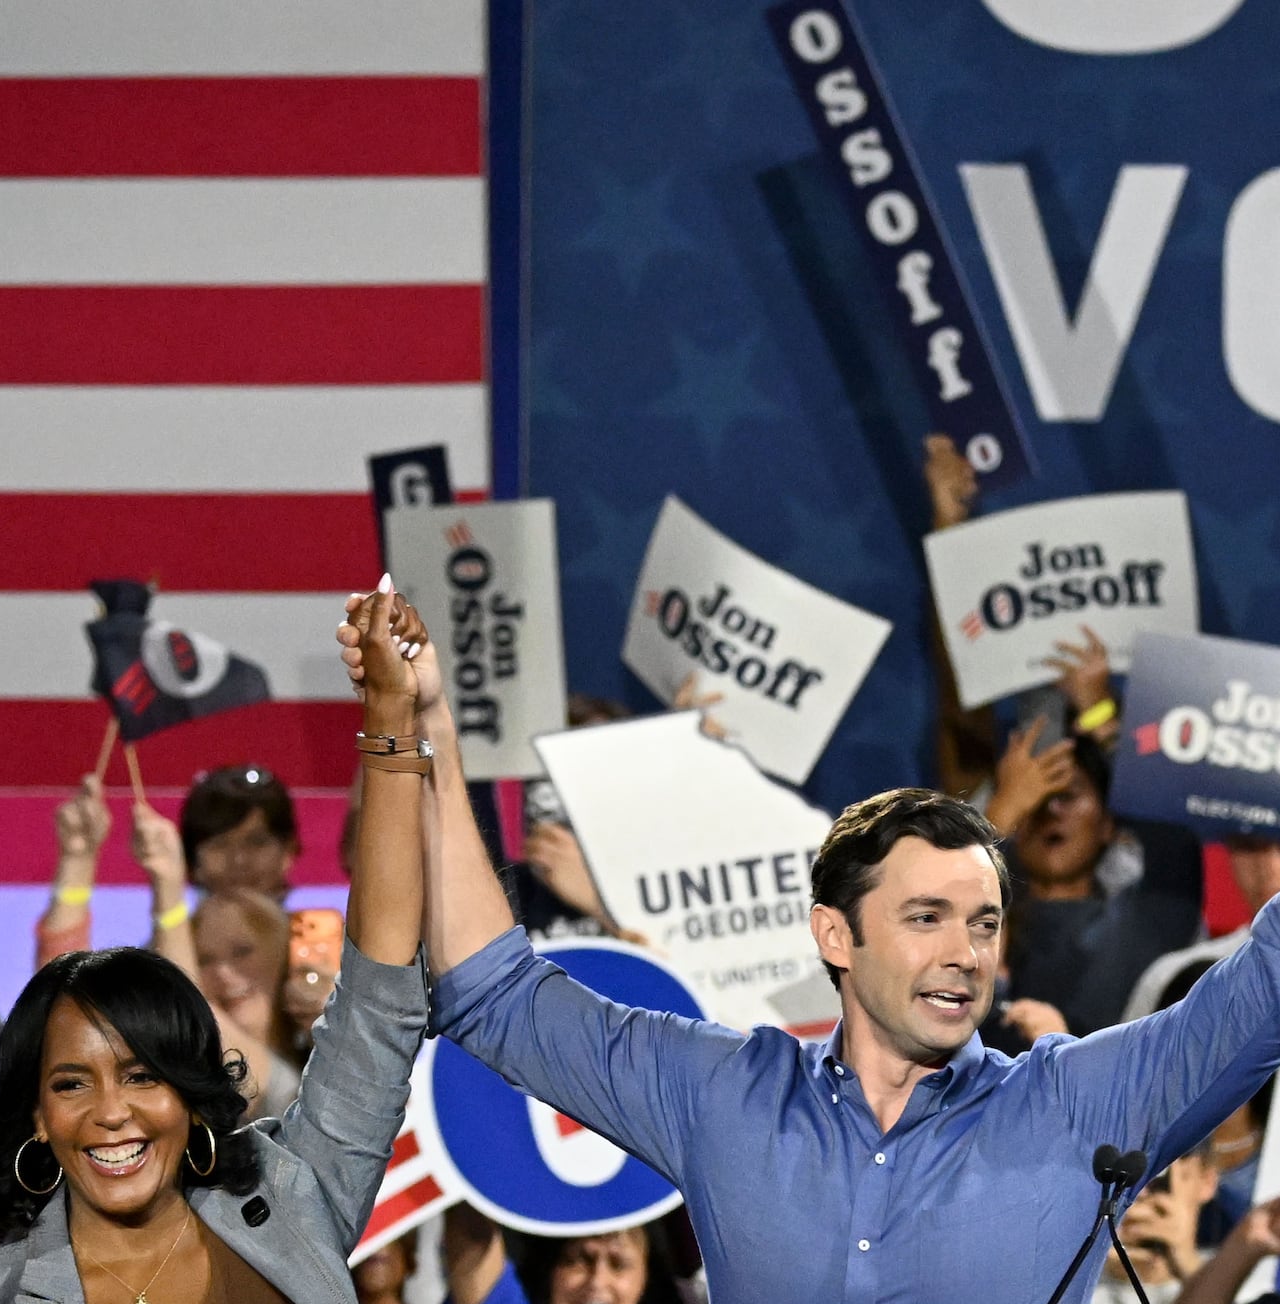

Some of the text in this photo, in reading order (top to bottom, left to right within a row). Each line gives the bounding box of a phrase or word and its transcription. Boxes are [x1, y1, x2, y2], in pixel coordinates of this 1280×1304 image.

[979, 560, 1166, 632] Ossoff
[1020, 541, 1106, 583] Jon
[446, 546, 501, 747] Ossoff
[488, 590, 526, 680] Jon
[655, 588, 823, 710] Ossoff
[696, 582, 779, 650] Jon
[637, 848, 821, 915] UNITE
[683, 899, 811, 942] GEORGI
